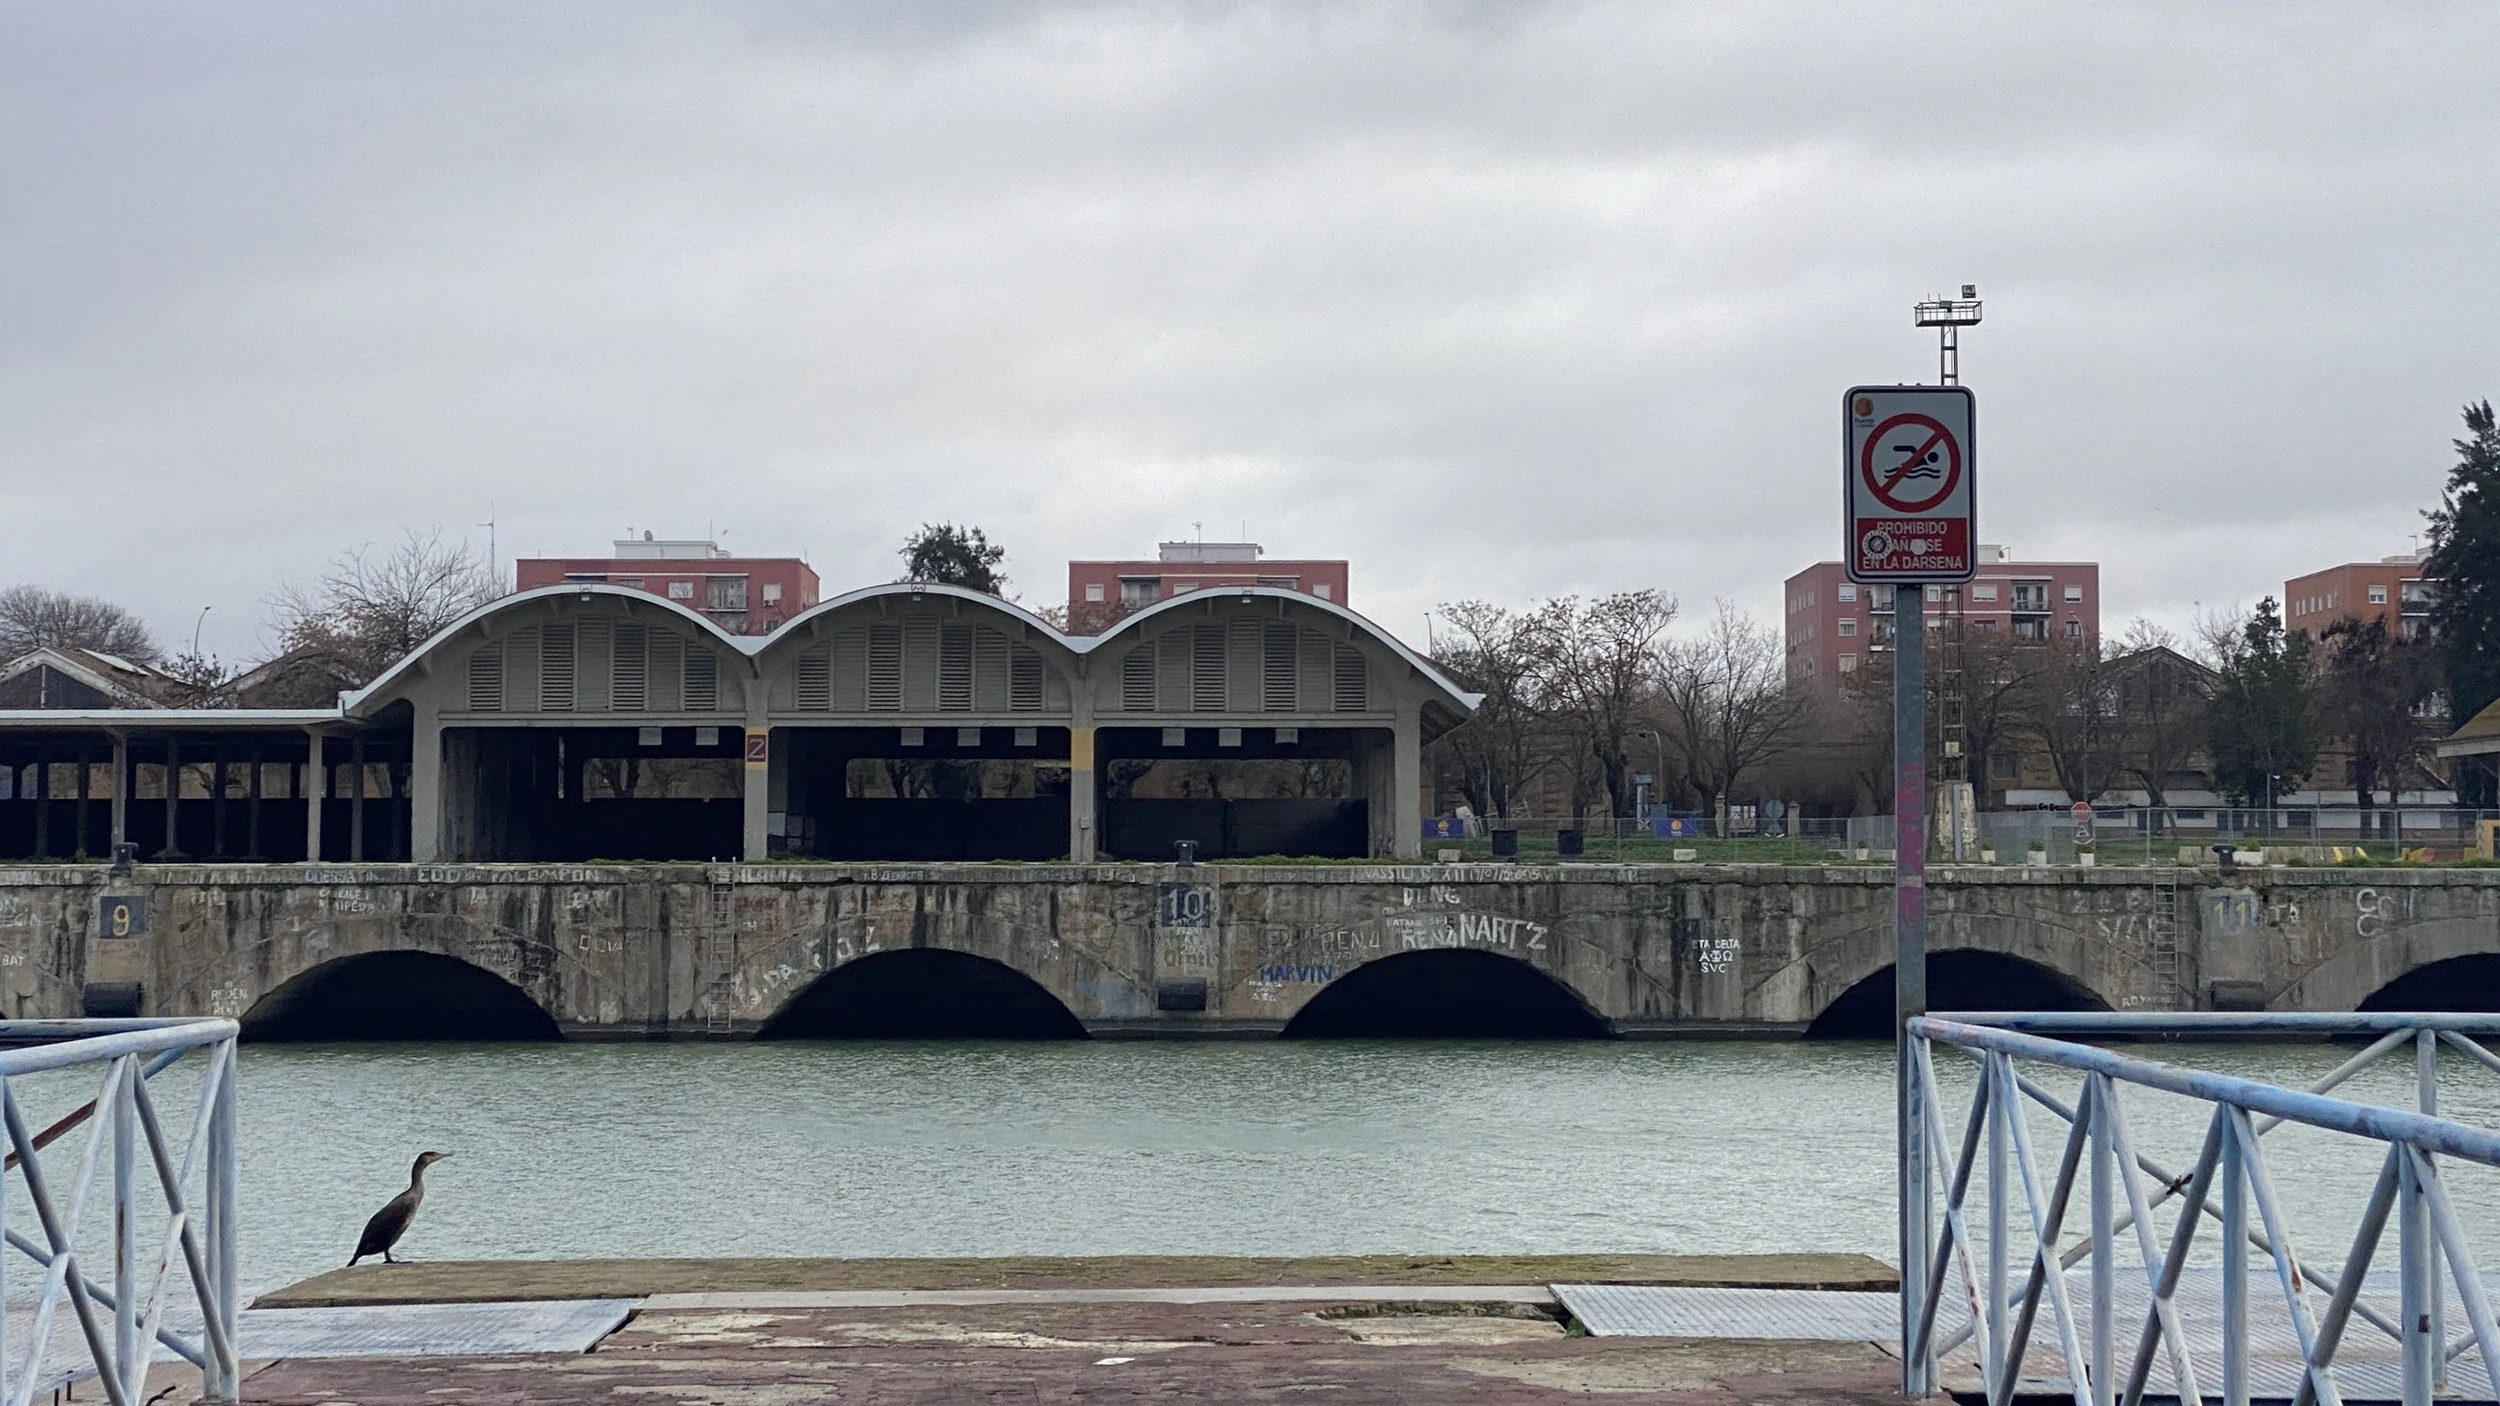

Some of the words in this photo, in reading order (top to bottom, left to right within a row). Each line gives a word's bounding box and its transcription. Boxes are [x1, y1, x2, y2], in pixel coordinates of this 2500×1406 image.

[1877, 521, 1947, 534] PROHIBIDO
[1863, 556, 1880, 569] EN
[1883, 556, 1899, 569] LA
[1902, 556, 1963, 569] DARSENA
[1168, 888, 1205, 920] 10
[112, 904, 130, 937] 9
[2214, 900, 2247, 931] 11
[1714, 938, 1741, 950] DELTA
[1259, 963, 1335, 983] MARVIN
[1700, 961, 1726, 974] SVC
